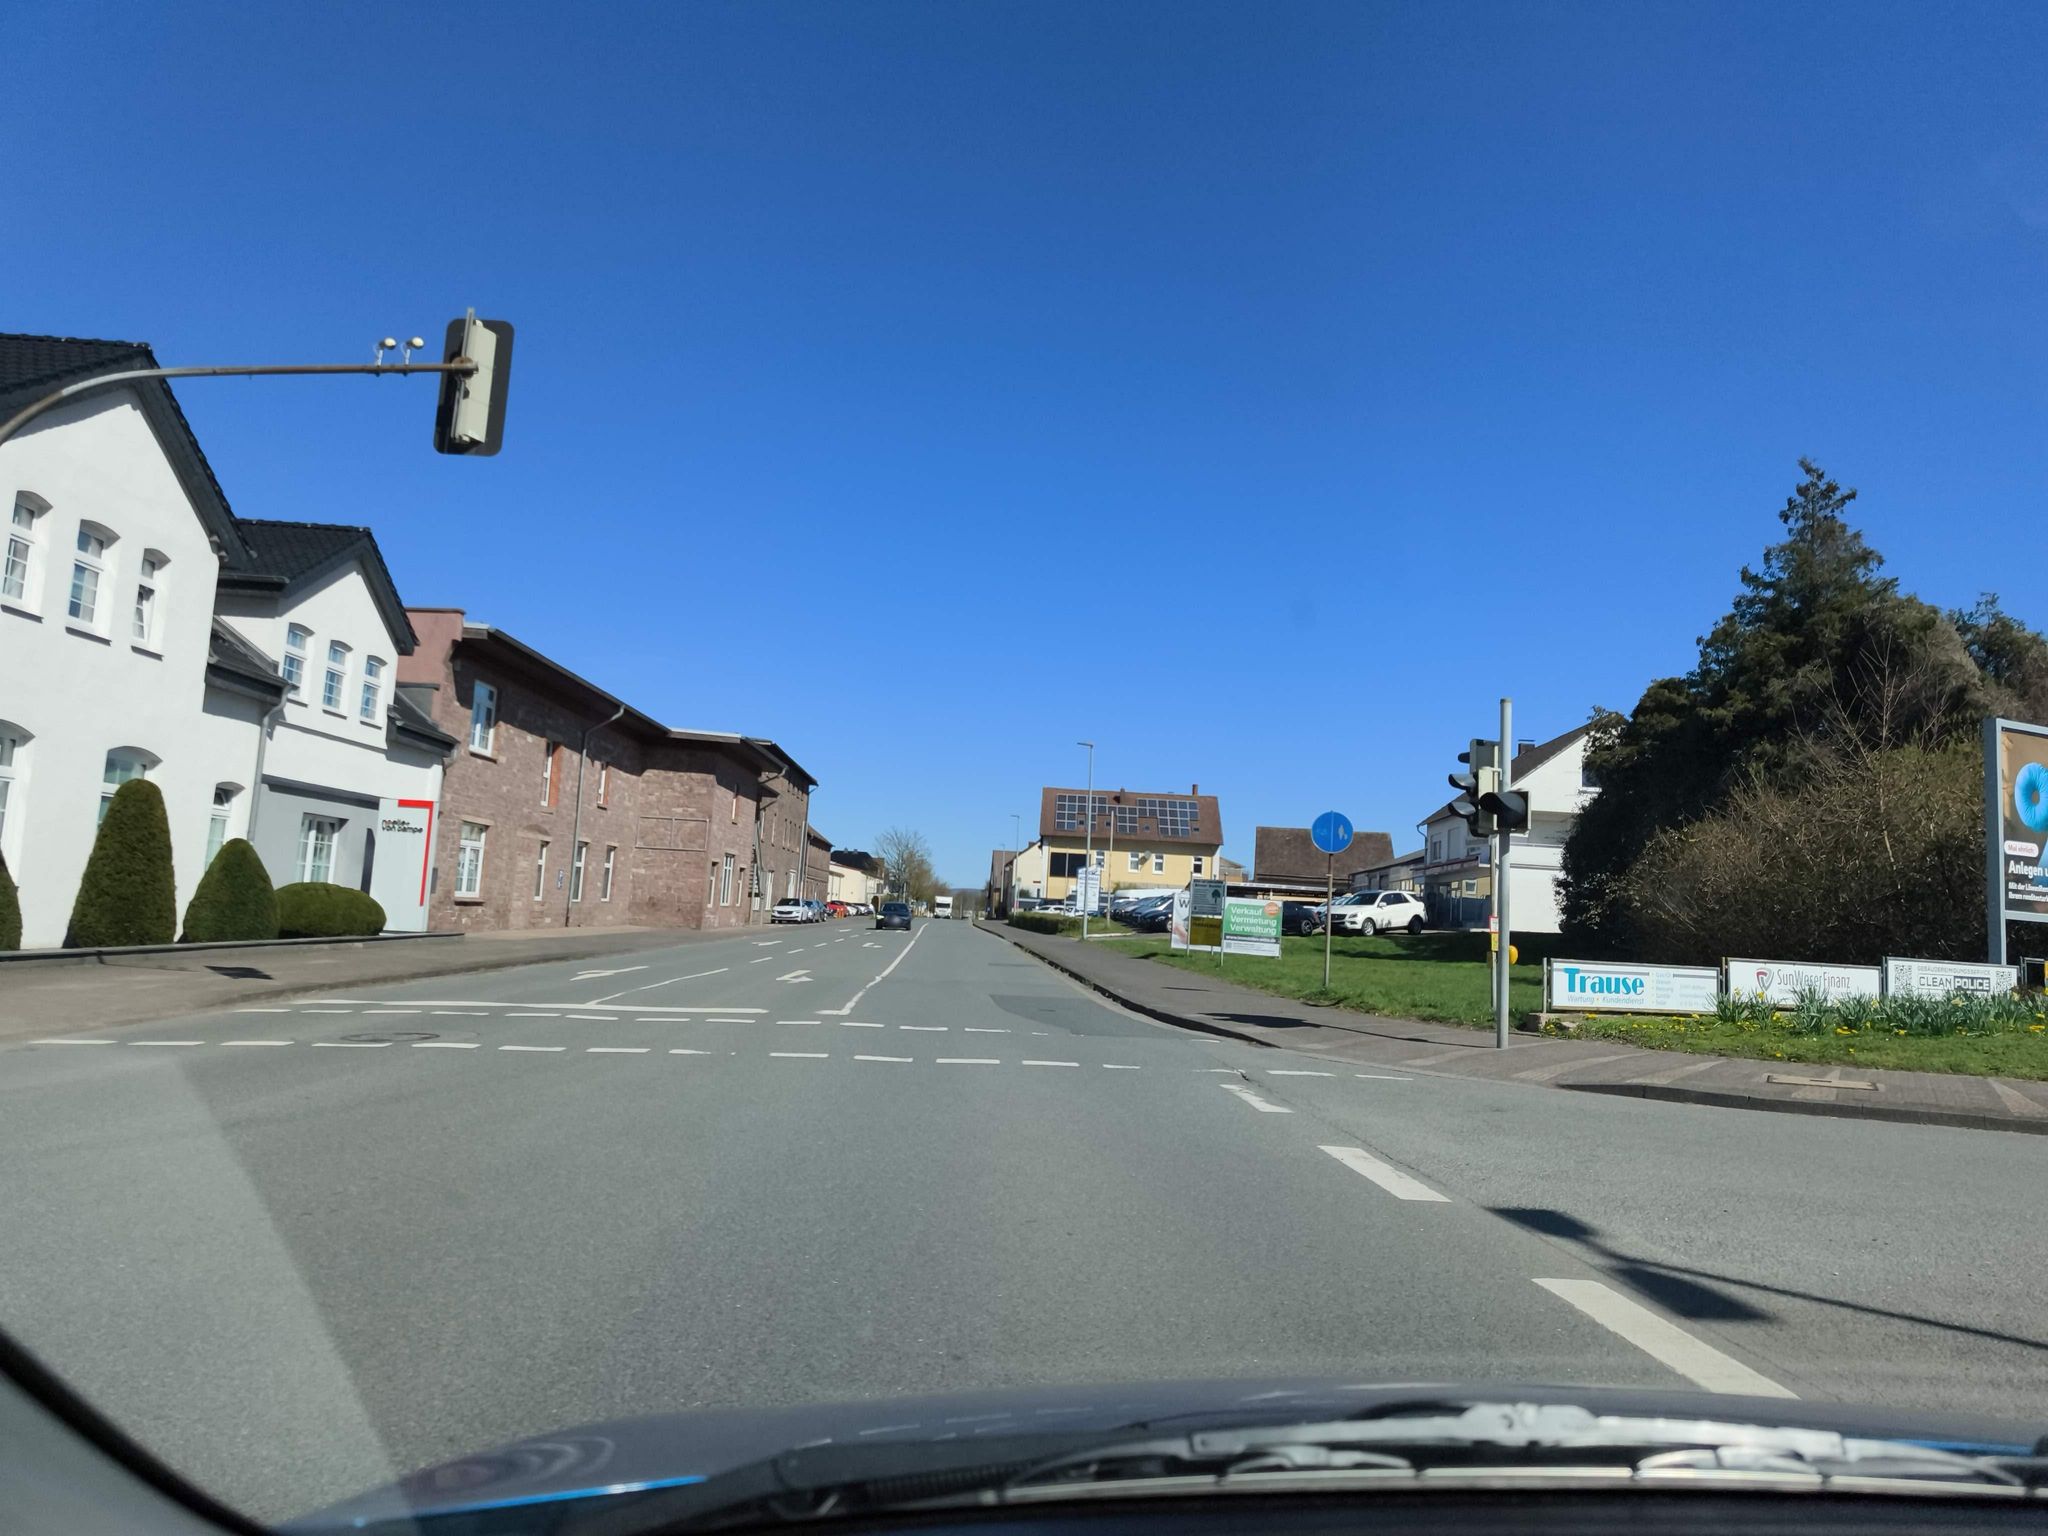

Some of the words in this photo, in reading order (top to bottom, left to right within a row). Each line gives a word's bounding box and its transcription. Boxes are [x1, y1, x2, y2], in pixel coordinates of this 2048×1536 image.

[2009, 860, 2043, 878] Anlegen
[1231, 905, 1262, 916] Verkauf
[1230, 914, 1277, 928] Vermietung
[1230, 923, 1277, 936] Verwaltung
[1563, 968, 1645, 995] Trause
[1919, 976, 1952, 989] CLEAN
[1954, 977, 1990, 990] POLICE
[1567, 994, 1595, 1005] Wartung
[1602, 995, 1645, 1005] Kundendienst
